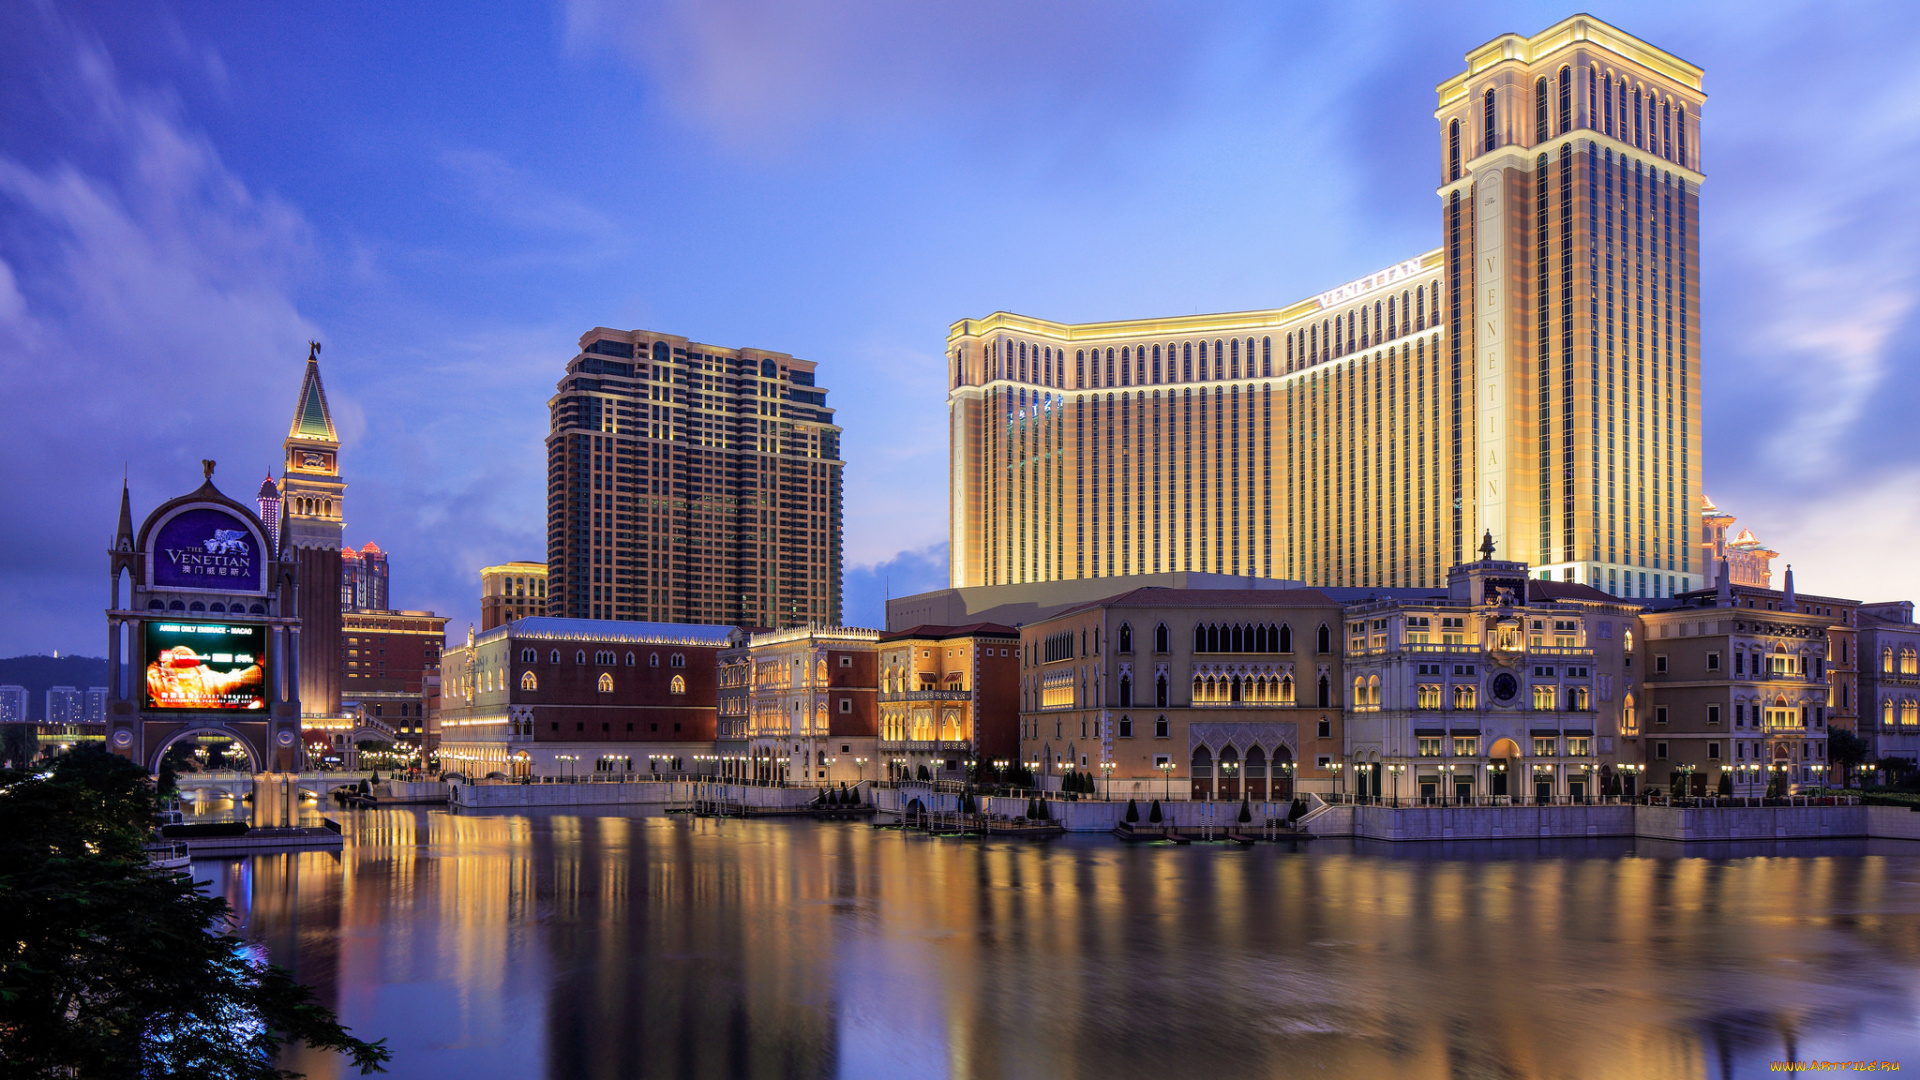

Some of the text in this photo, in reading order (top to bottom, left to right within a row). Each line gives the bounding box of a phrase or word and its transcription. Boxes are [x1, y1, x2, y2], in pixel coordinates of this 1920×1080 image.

[1318, 258, 1422, 308] VENETIAN
[1486, 256, 1498, 498] VENETIAN
[165, 548, 251, 567] VENETIAN
[186, 546, 204, 554] THE
[181, 565, 252, 578] 澳门威尼斯人
[181, 625, 197, 633] ONLY
[197, 626, 227, 634] EMBRACE
[230, 627, 253, 635] MACAO
